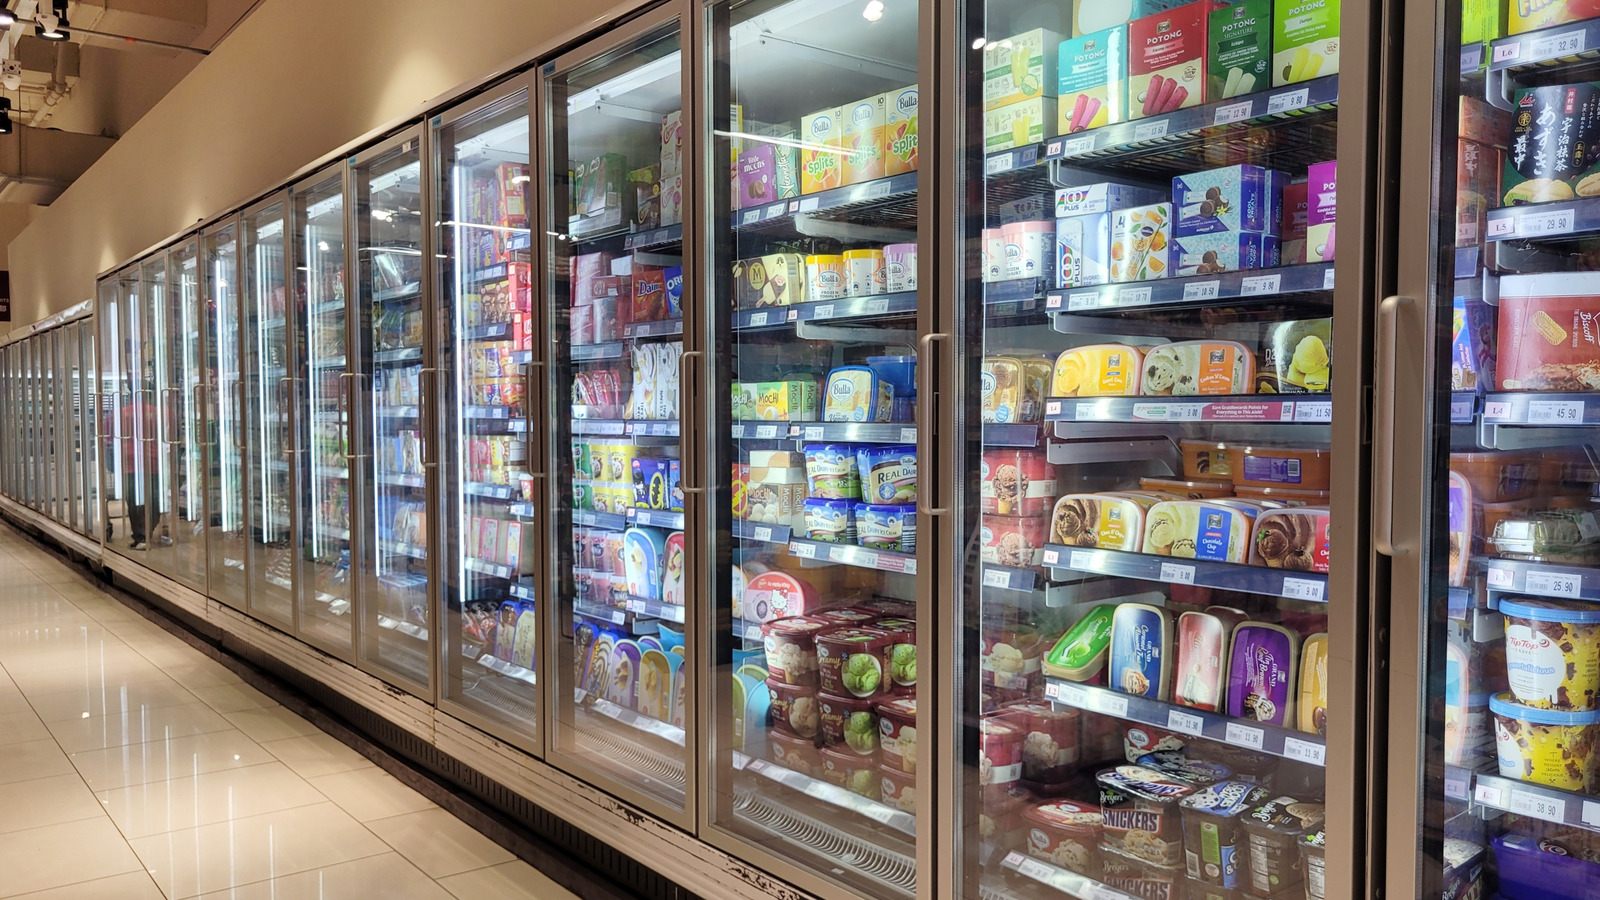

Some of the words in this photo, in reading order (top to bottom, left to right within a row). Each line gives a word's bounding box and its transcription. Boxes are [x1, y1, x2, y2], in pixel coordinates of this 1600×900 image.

[1289, 0, 1325, 16] POTONG
[1222, 18, 1256, 32] POTONG
[1147, 31, 1182, 45] POTONG
[1224, 27, 1253, 39] SIGNATURE
[1558, 38, 1578, 51] 32.90
[1074, 50, 1105, 62] POTONG
[878, 97, 884, 105] 10
[899, 96, 917, 110] Bulla
[854, 109, 870, 122] Bulla
[814, 122, 829, 134] Bulla
[893, 135, 918, 154] split
[1533, 101, 1556, 175] あずき
[1554, 116, 1574, 172] 宇治抹茶
[1513, 134, 1527, 171] 最中
[1546, 218, 1567, 230] 29.90
[752, 268, 762, 281] M
[638, 280, 660, 296] Daim
[1580, 311, 1595, 345] Biscoff
[1265, 348, 1276, 360] D2
[833, 383, 851, 396] Bulla
[1556, 408, 1577, 419] 45.90
[877, 470, 901, 485] REAL
[902, 467, 917, 477] DAIR
[1202, 538, 1223, 547] Chocolate
[1553, 580, 1574, 593] 25.90
[1099, 790, 1123, 804] Breyers
[1536, 802, 1556, 816] 38.90
[1102, 808, 1158, 832] SNICKERS
